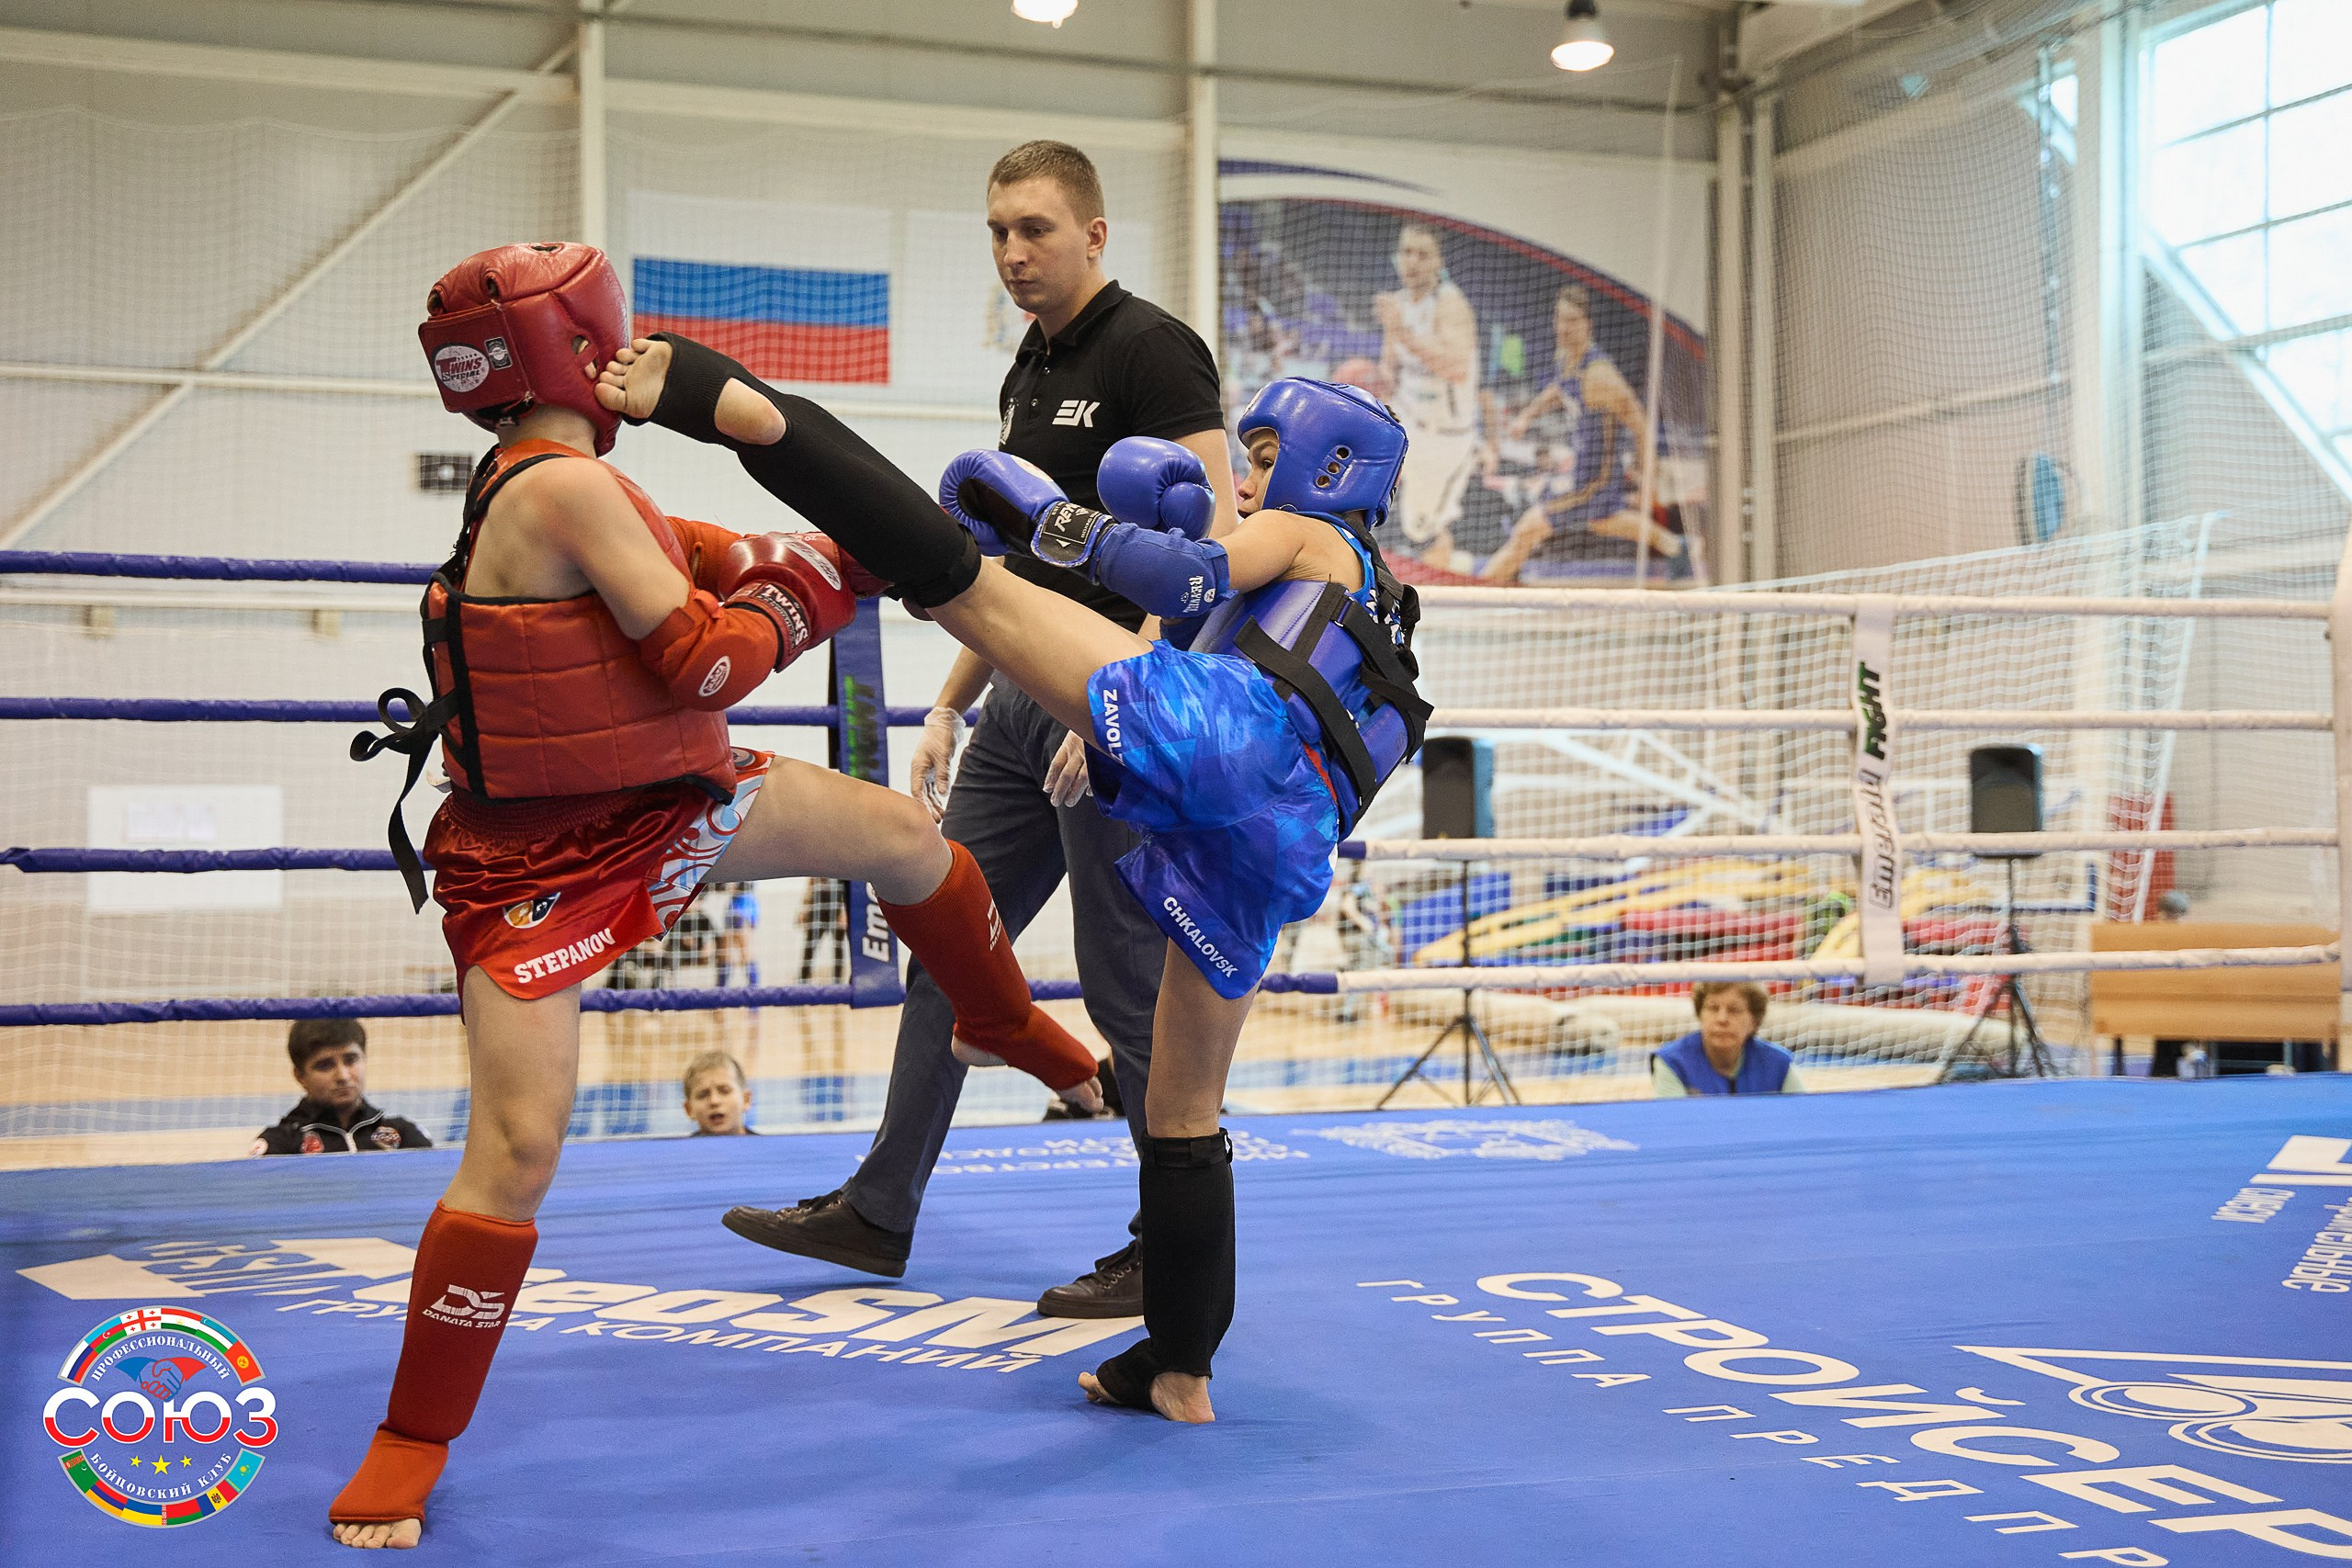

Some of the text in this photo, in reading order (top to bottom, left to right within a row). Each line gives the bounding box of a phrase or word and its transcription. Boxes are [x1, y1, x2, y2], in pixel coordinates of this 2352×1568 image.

[436, 356, 483, 375] TWINS
[1052, 400, 1101, 428] EK
[761, 583, 808, 646] TWINS
[1858, 661, 1888, 761] FIGHT
[514, 928, 616, 984] STEPANOV
[1163, 896, 1238, 978] CHKALOVSK
[423, 1309, 473, 1327] DANATA
[559, 1321, 1043, 1373] КОМПАНИЙ
[1356, 1280, 2169, 1567] ГРУППА ПРЕДПР
